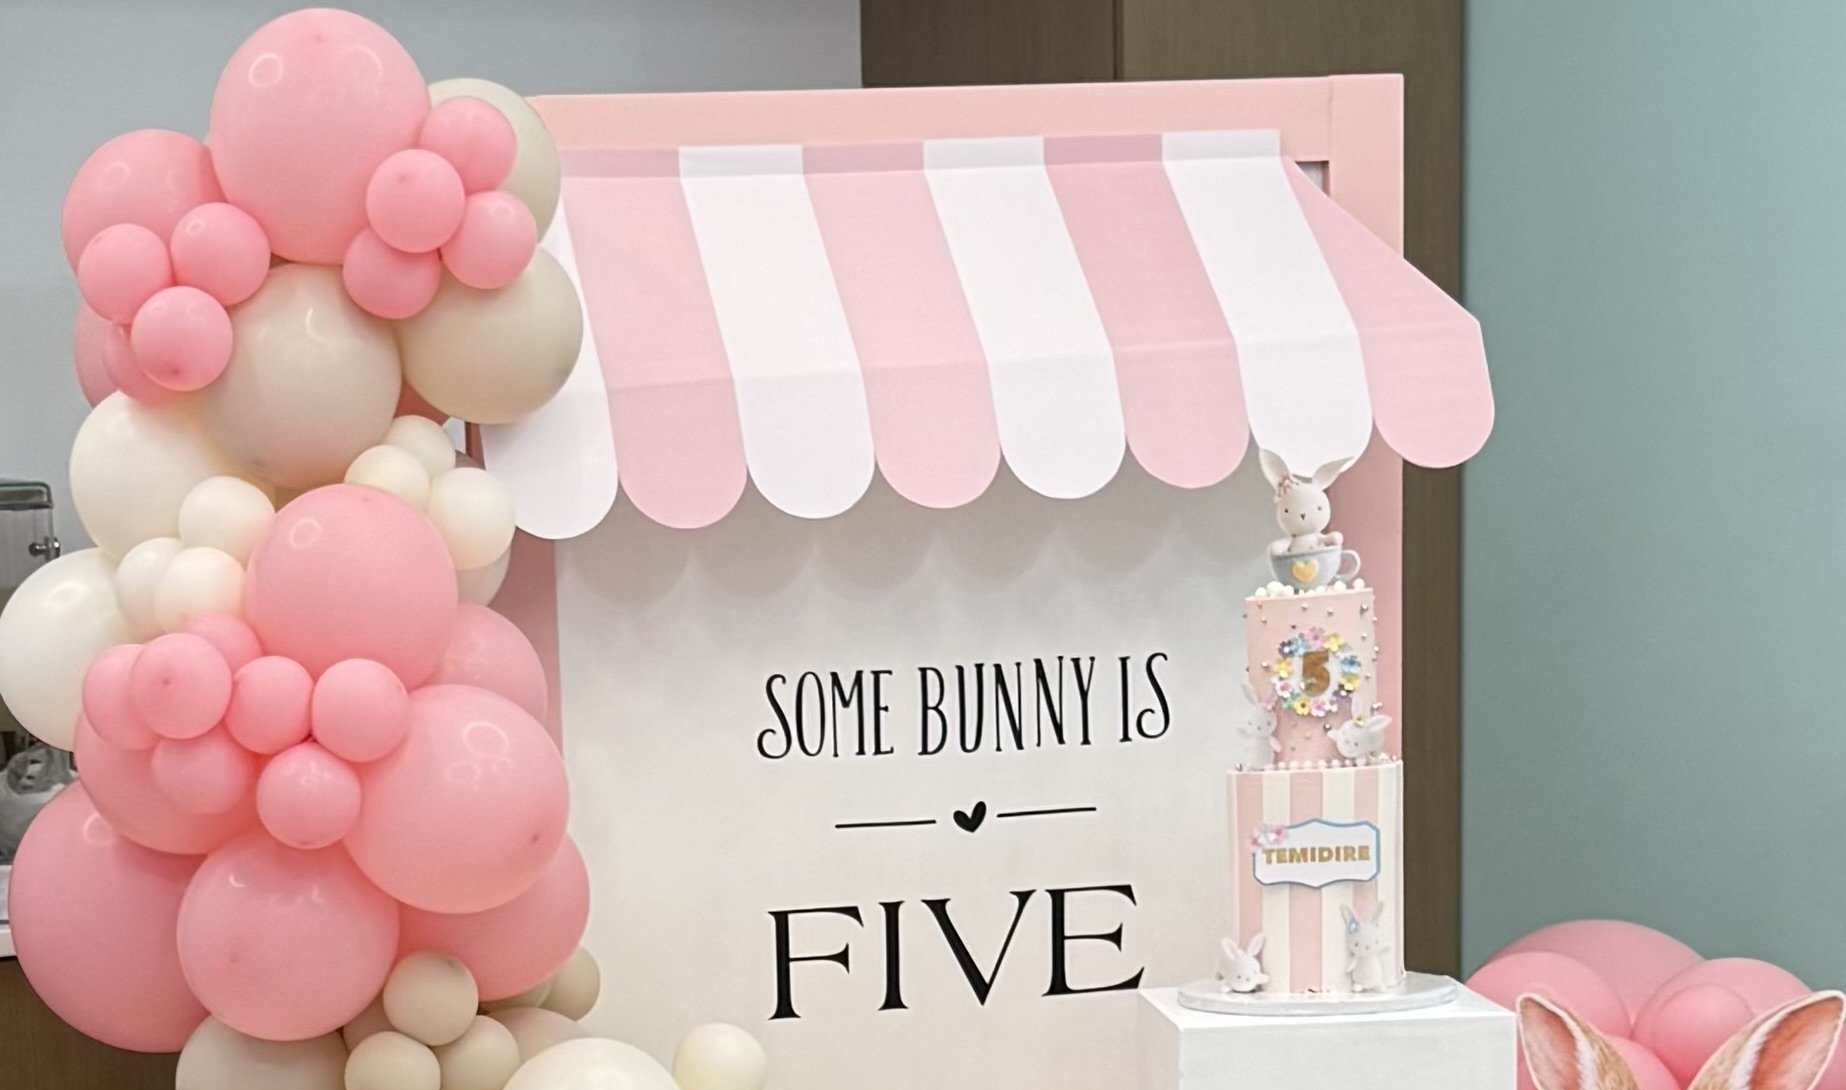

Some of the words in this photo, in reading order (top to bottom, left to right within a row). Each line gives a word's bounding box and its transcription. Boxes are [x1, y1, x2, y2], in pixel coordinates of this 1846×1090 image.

[757, 668, 894, 760] SOME
[916, 655, 1097, 757] BUNNY
[1118, 652, 1171, 744] IS
[1302, 649, 1330, 698] 5
[1262, 845, 1370, 865] TEMIDIRE
[767, 884, 1146, 1020] FIVE
